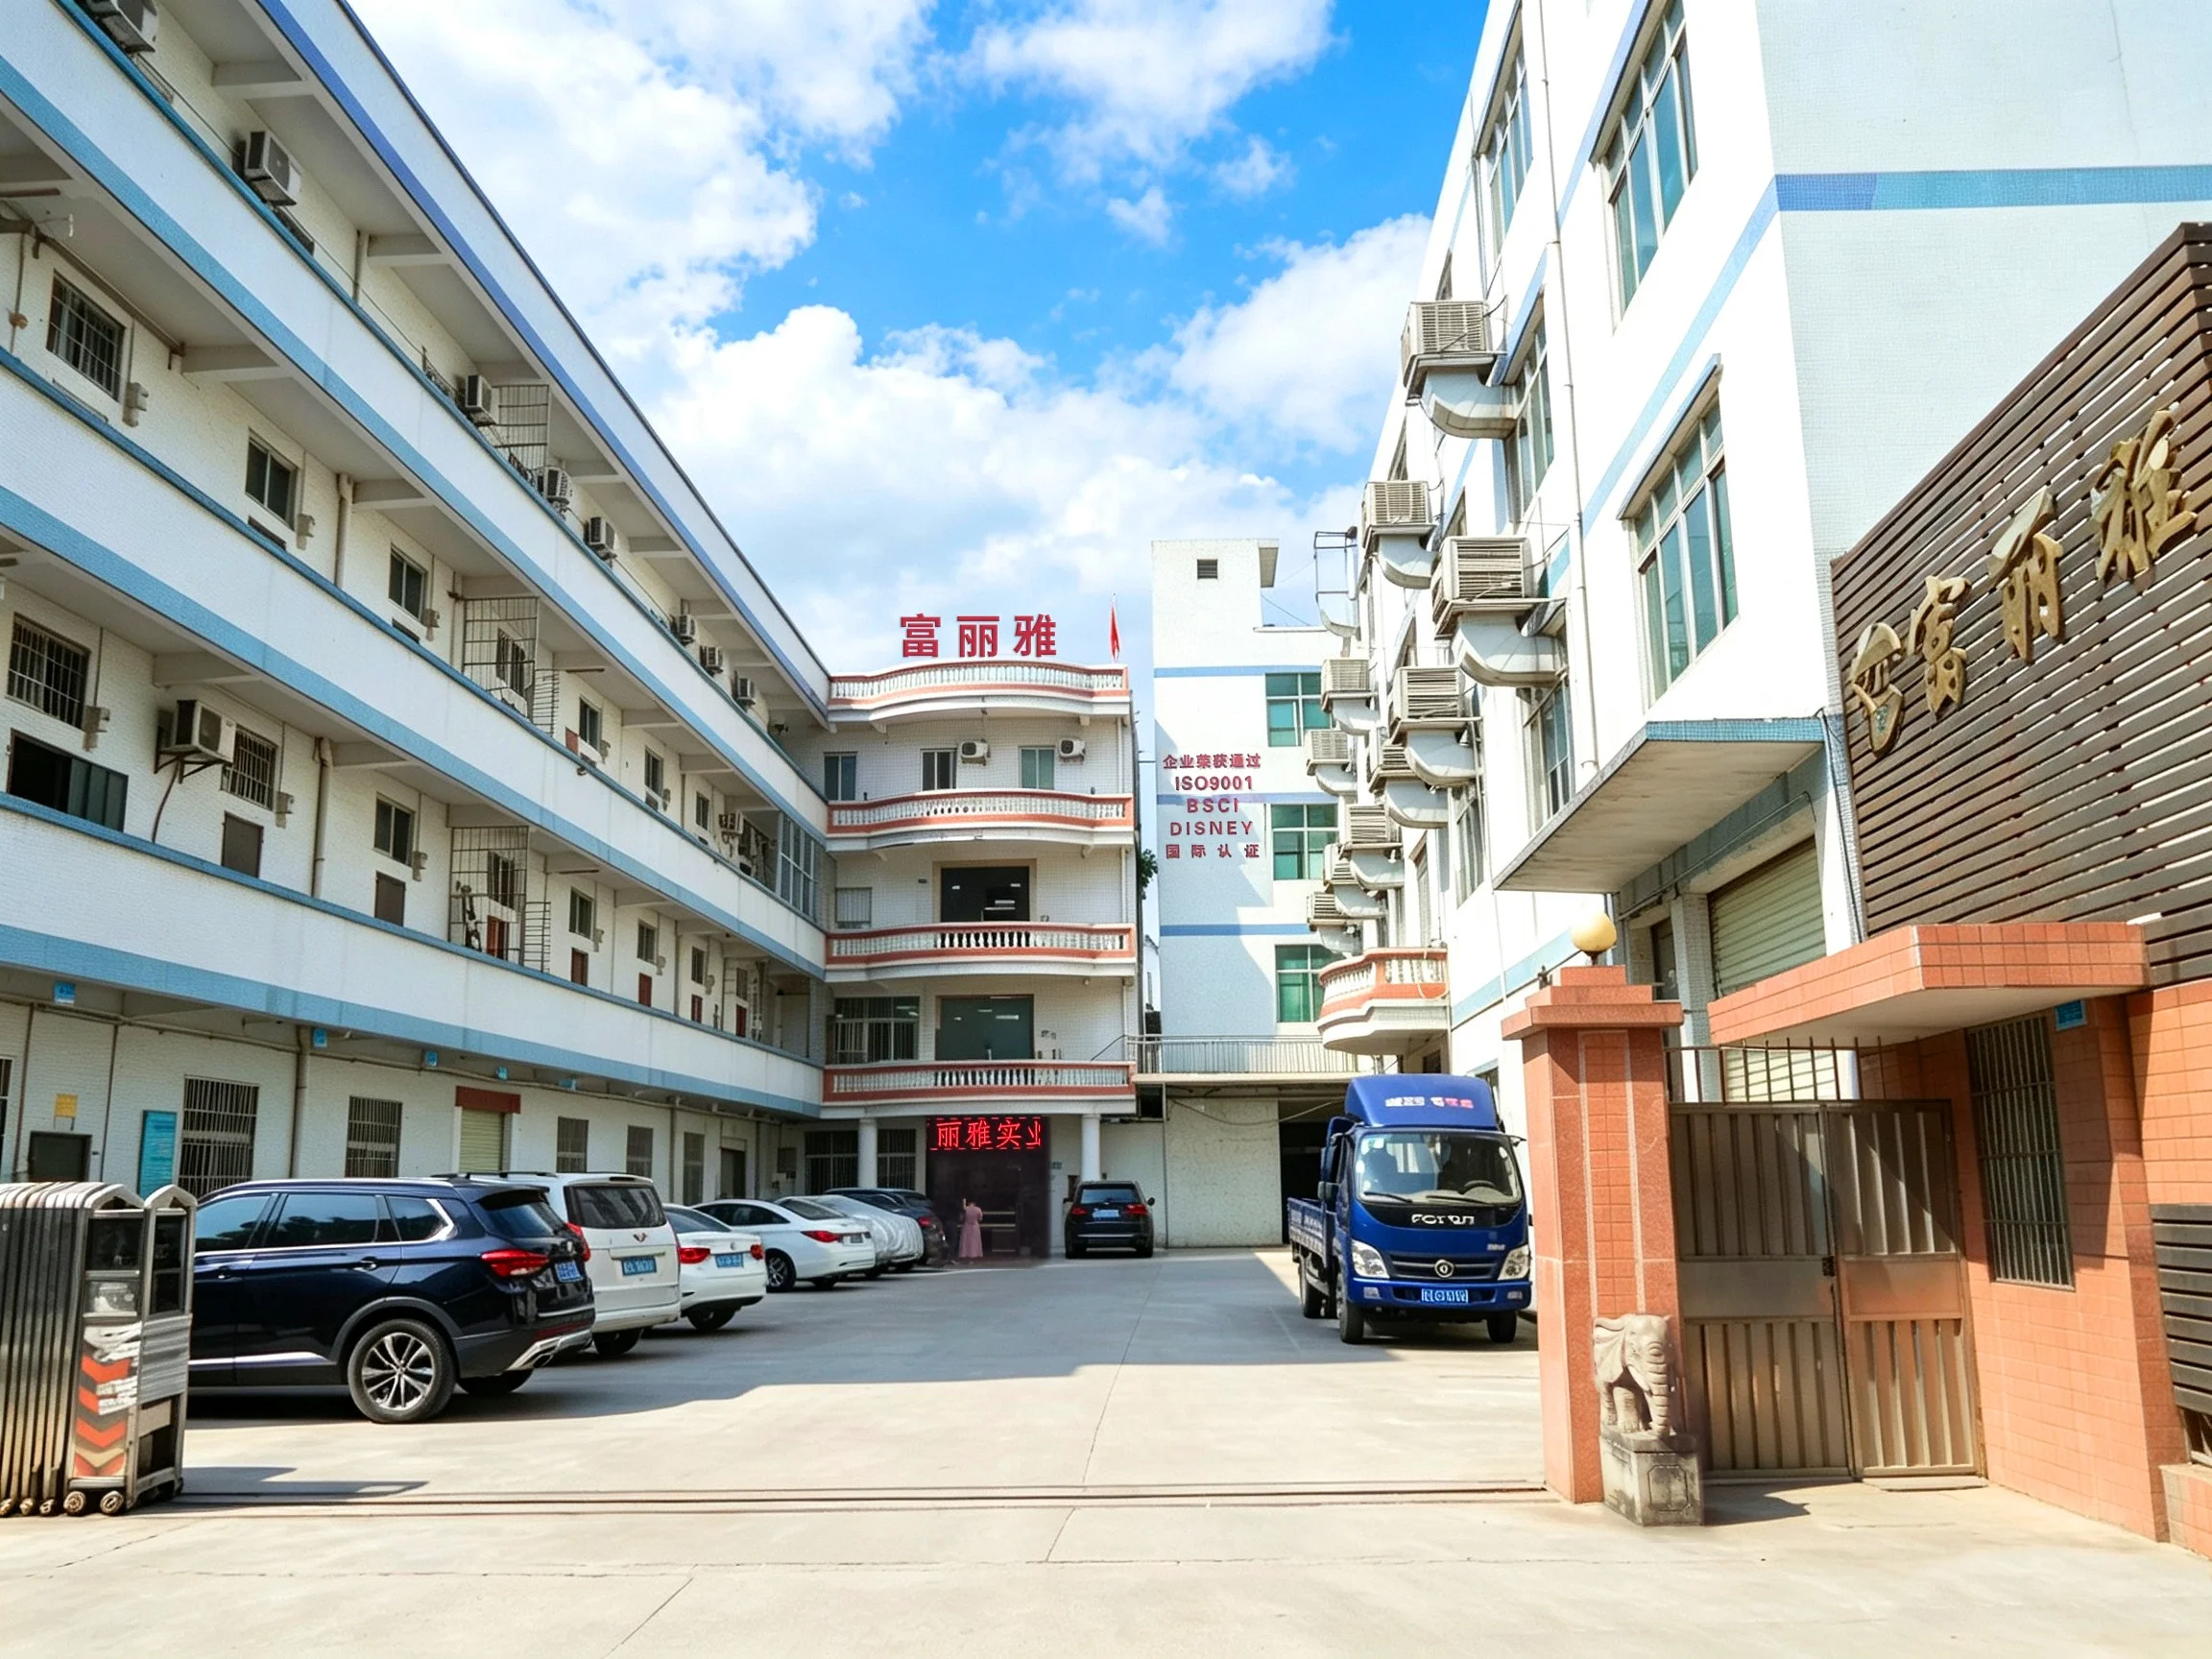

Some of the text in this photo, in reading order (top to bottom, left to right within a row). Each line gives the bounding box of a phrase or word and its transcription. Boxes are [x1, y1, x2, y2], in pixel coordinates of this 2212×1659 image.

[900, 613, 1057, 658] 富丽雅
[1163, 753, 1261, 769] 企业荣获通过
[1175, 775, 1253, 791] ISO9001
[1187, 798, 1238, 813] BSCI
[1169, 821, 1253, 836] DISNEY
[1166, 844, 1261, 859] 国际认证
